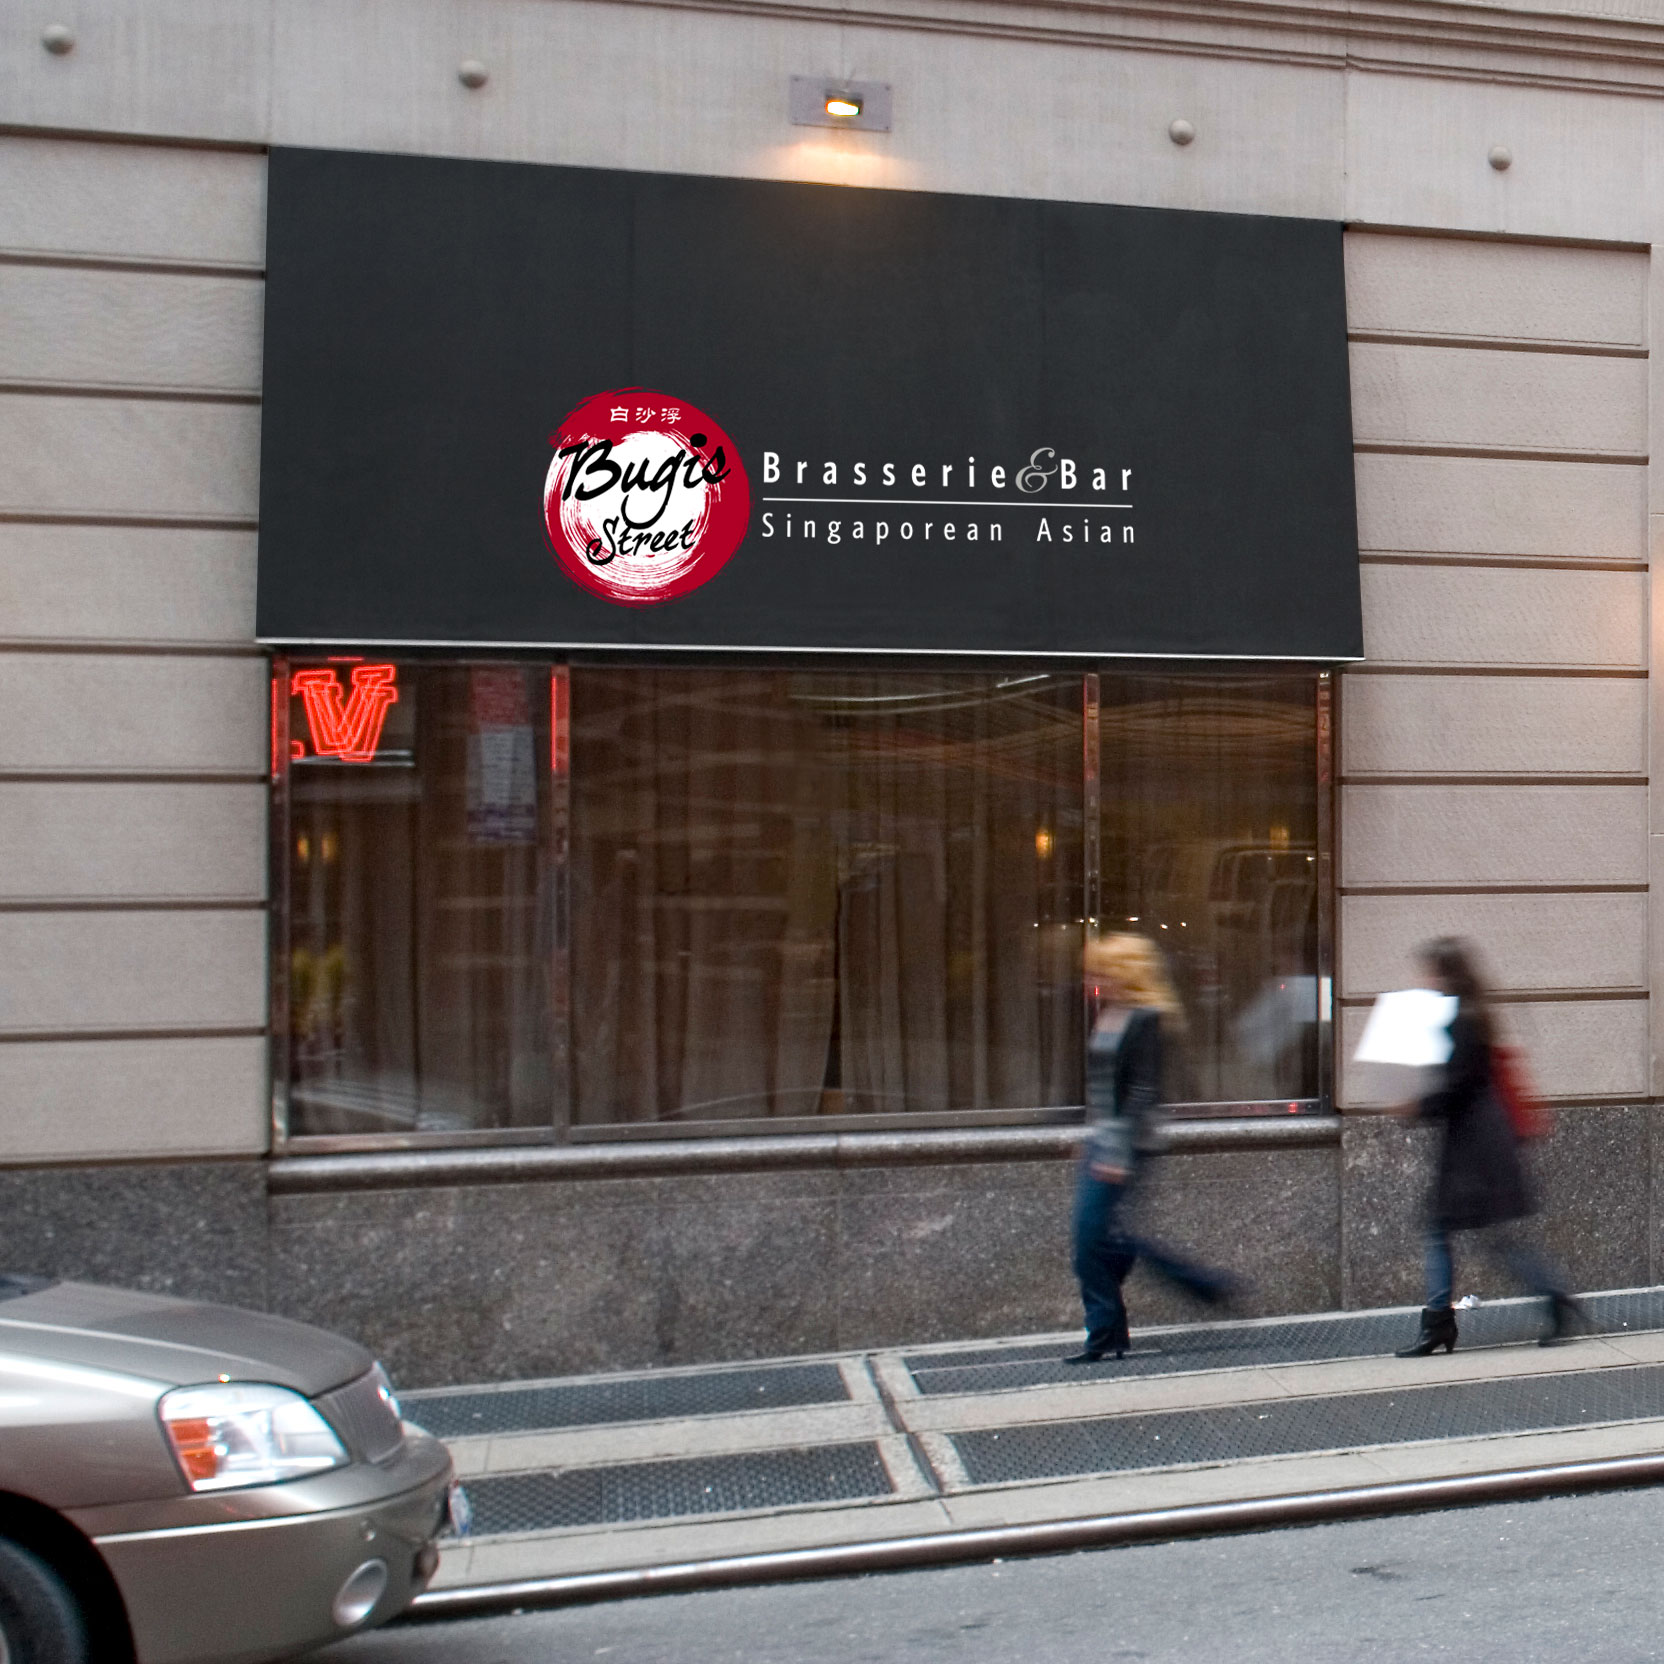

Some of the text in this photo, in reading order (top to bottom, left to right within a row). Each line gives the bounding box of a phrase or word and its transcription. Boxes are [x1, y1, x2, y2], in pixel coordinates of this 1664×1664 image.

[610, 406, 682, 424] 白沙浮
[558, 433, 731, 530] Bugis
[763, 451, 1007, 488] Brasserie
[1060, 458, 1133, 491] Bar
[586, 516, 696, 566] Street
[762, 512, 1135, 545] Singaporean Asian
